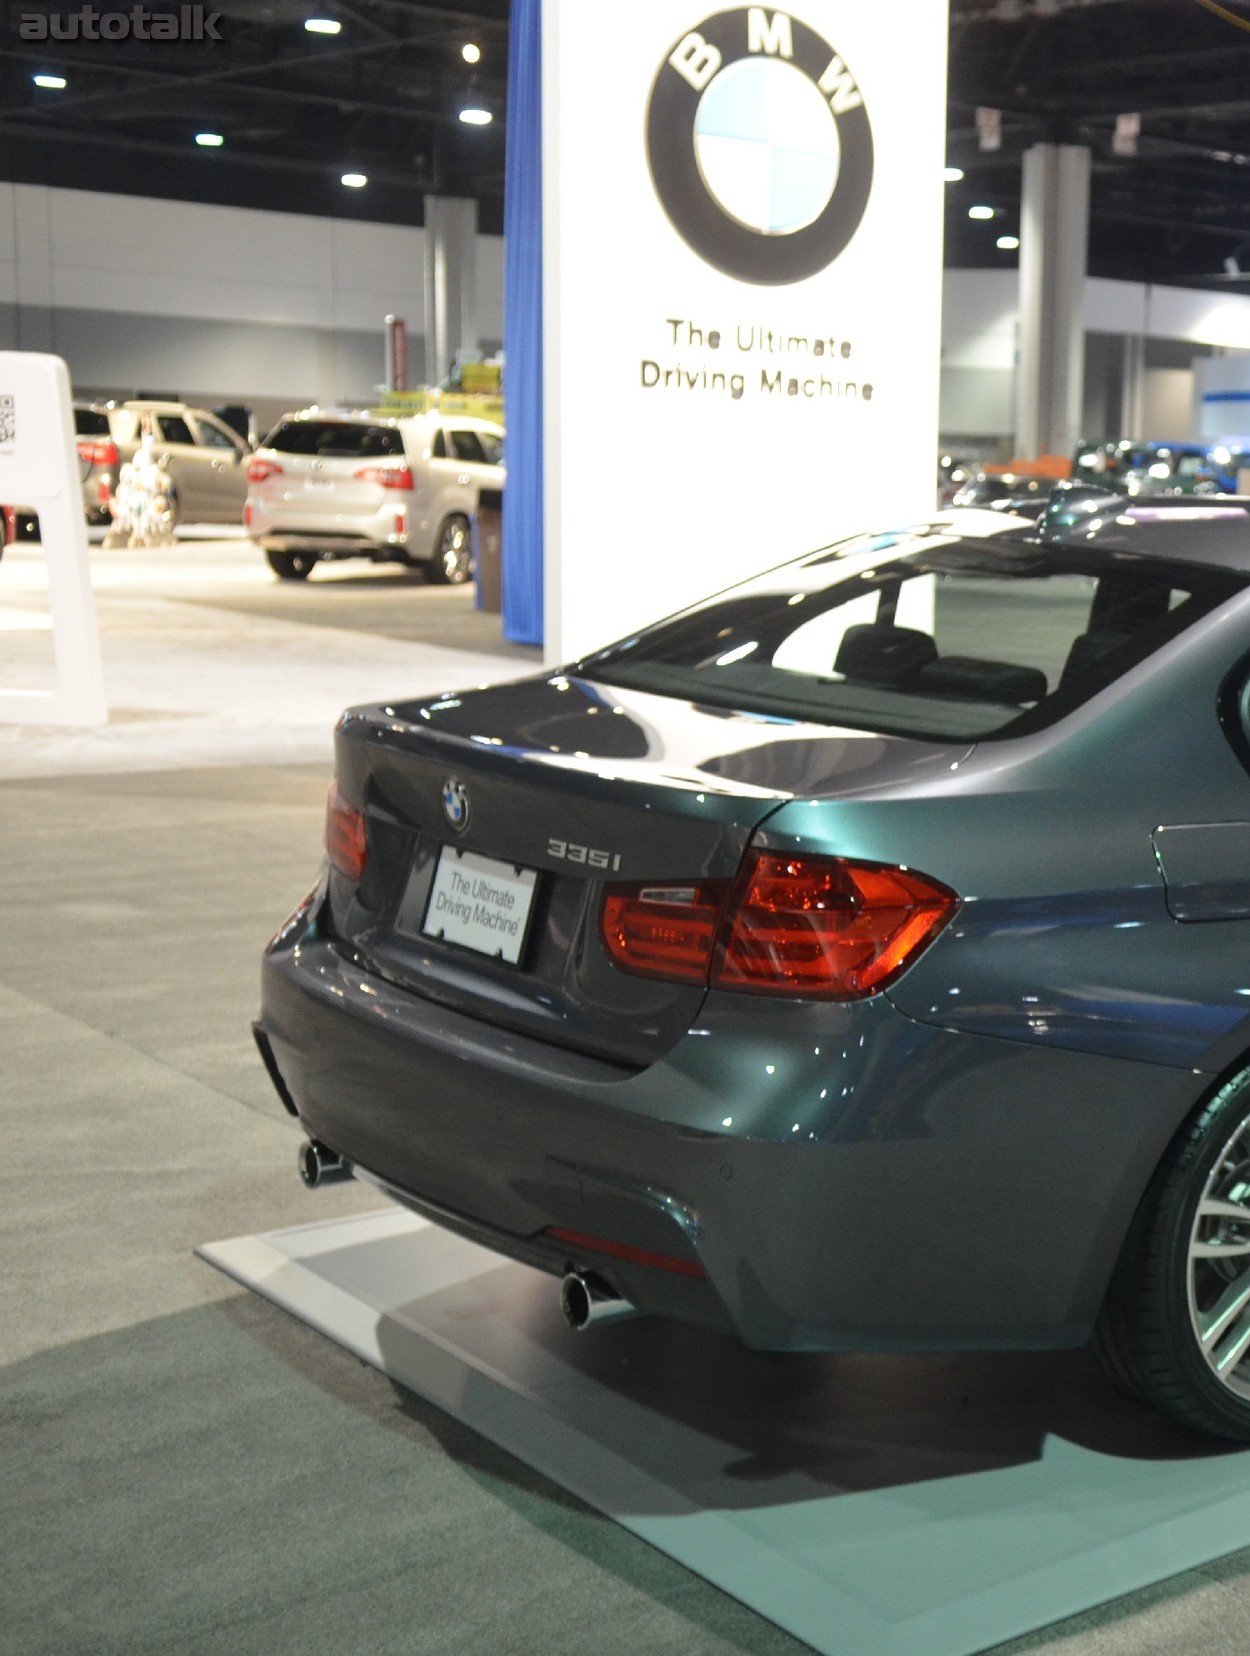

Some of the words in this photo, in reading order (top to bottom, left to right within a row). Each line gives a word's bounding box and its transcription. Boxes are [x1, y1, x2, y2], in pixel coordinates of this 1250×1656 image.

[669, 7, 866, 115] BMW
[666, 318, 721, 349] The
[736, 325, 852, 360] Ultimate
[641, 359, 745, 400] Driving
[760, 368, 874, 401] Machine
[435, 891, 471, 925] Driving
[451, 871, 471, 895] The
[471, 878, 515, 910] Ultimate
